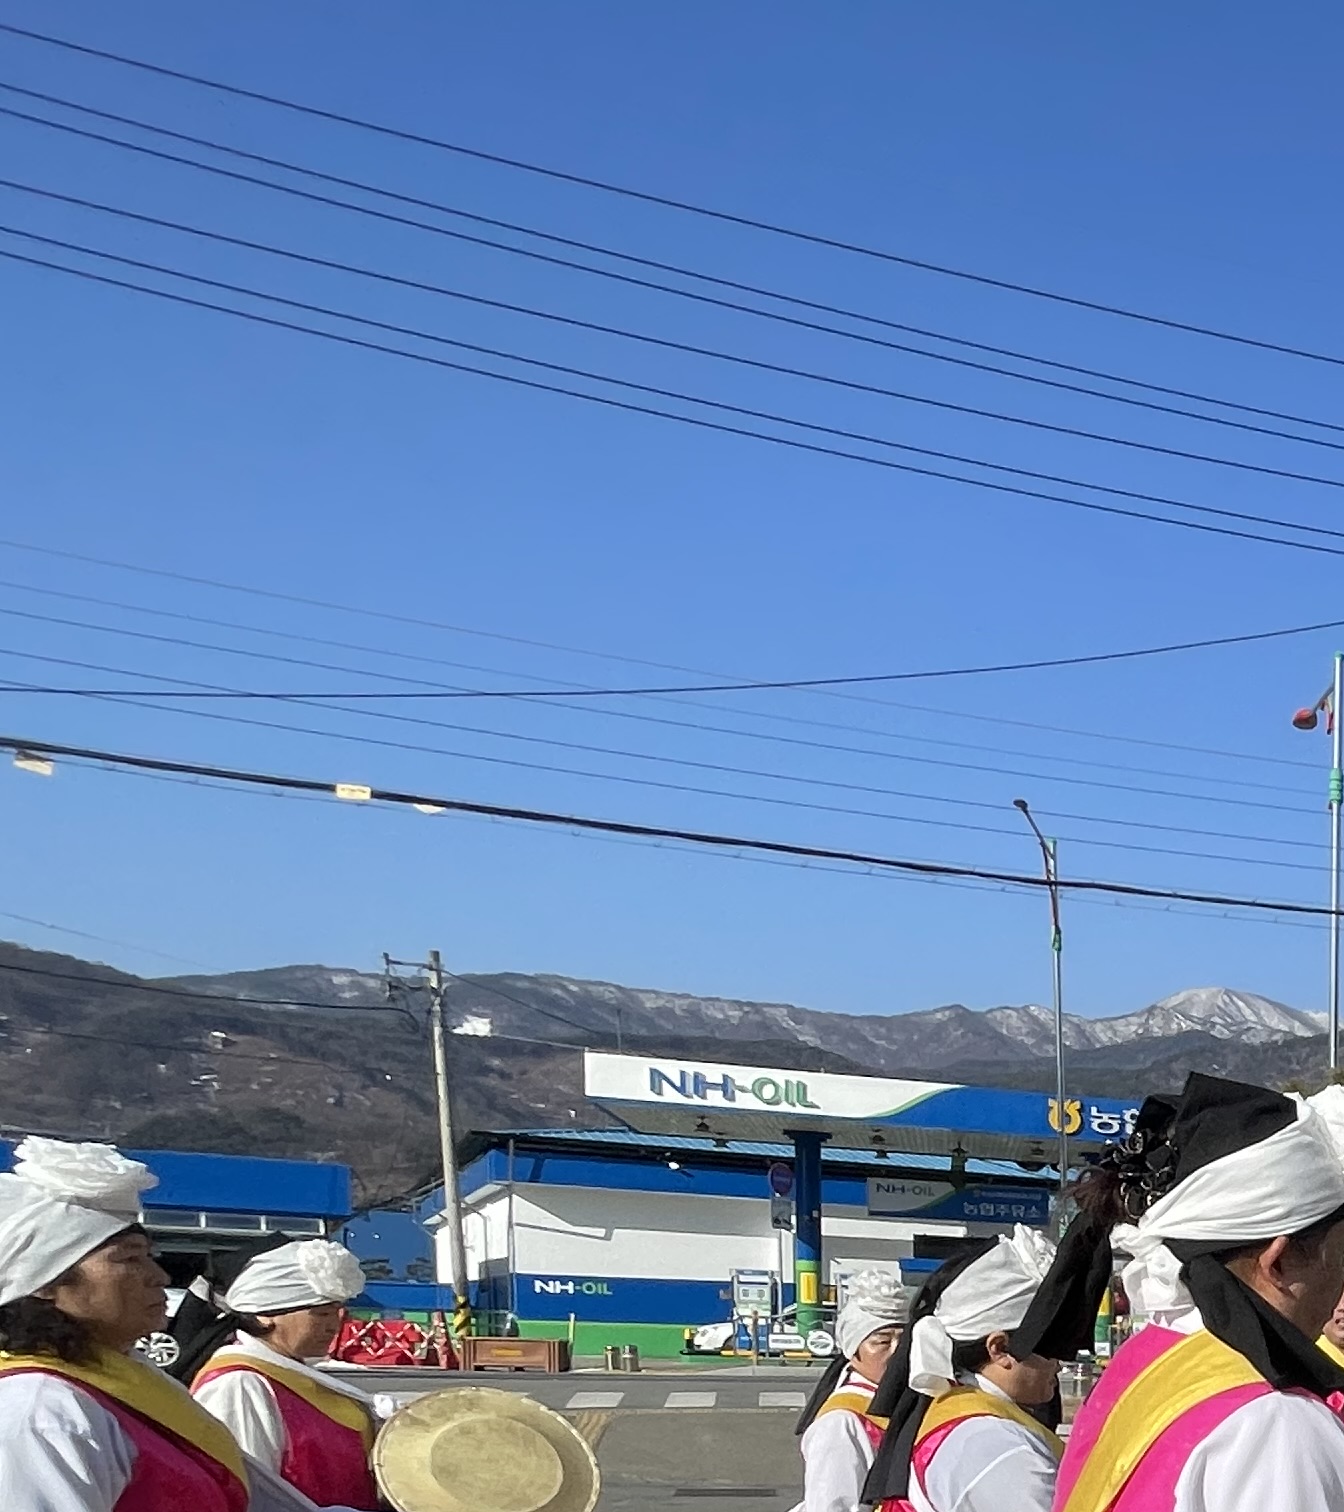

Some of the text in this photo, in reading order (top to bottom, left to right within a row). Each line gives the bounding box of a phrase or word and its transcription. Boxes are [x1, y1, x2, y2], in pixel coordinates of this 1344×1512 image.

[649, 1067, 822, 1109] NH-OIL
[876, 1183, 935, 1197] NH-OIL
[533, 1279, 613, 1295] NH-OIL
